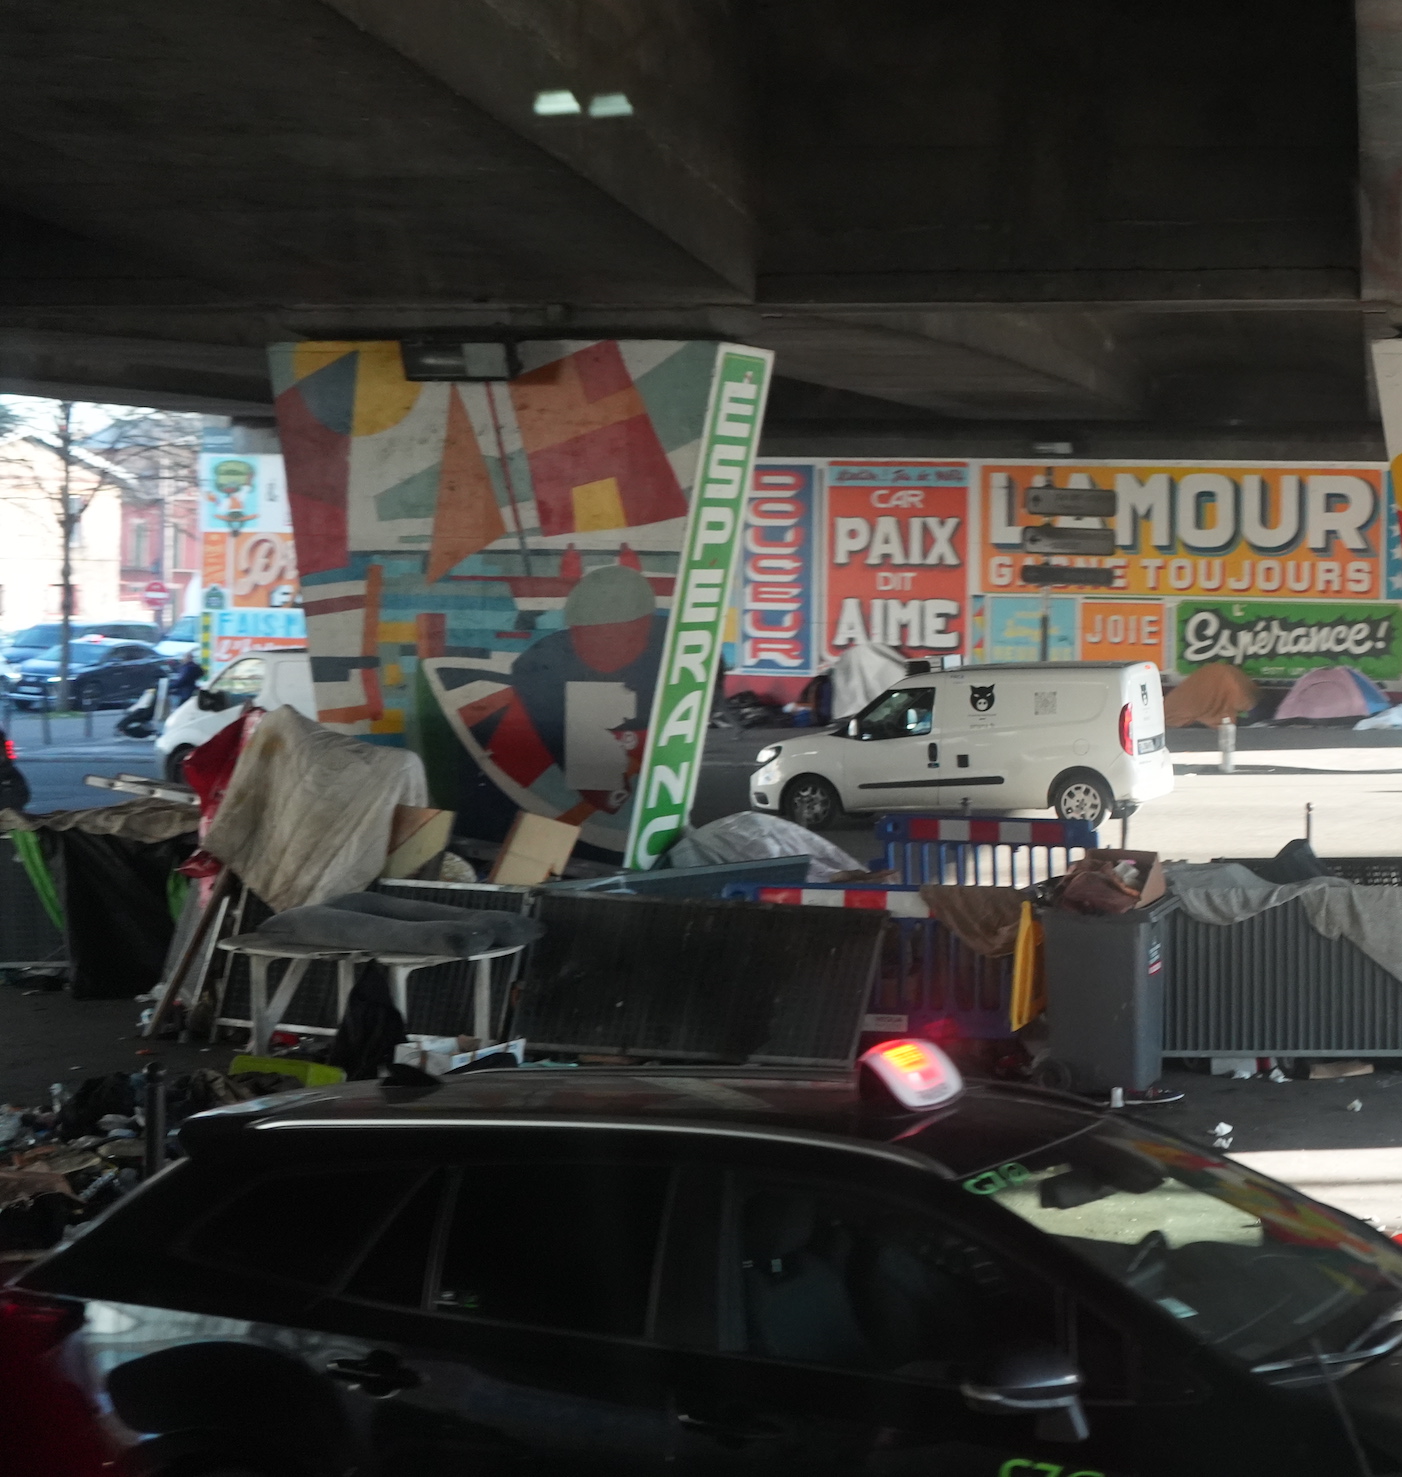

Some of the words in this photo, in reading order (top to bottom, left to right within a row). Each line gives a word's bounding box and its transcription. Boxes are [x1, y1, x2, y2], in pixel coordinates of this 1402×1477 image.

[870, 489, 925, 509] CAR
[833, 516, 963, 567] PAIX
[876, 572, 917, 591] DIT
[1140, 558, 1374, 593] TOUJOURS
[832, 598, 962, 648] AIME
[1086, 614, 1160, 645] JOIE
[1184, 610, 1391, 665] Espérance!
